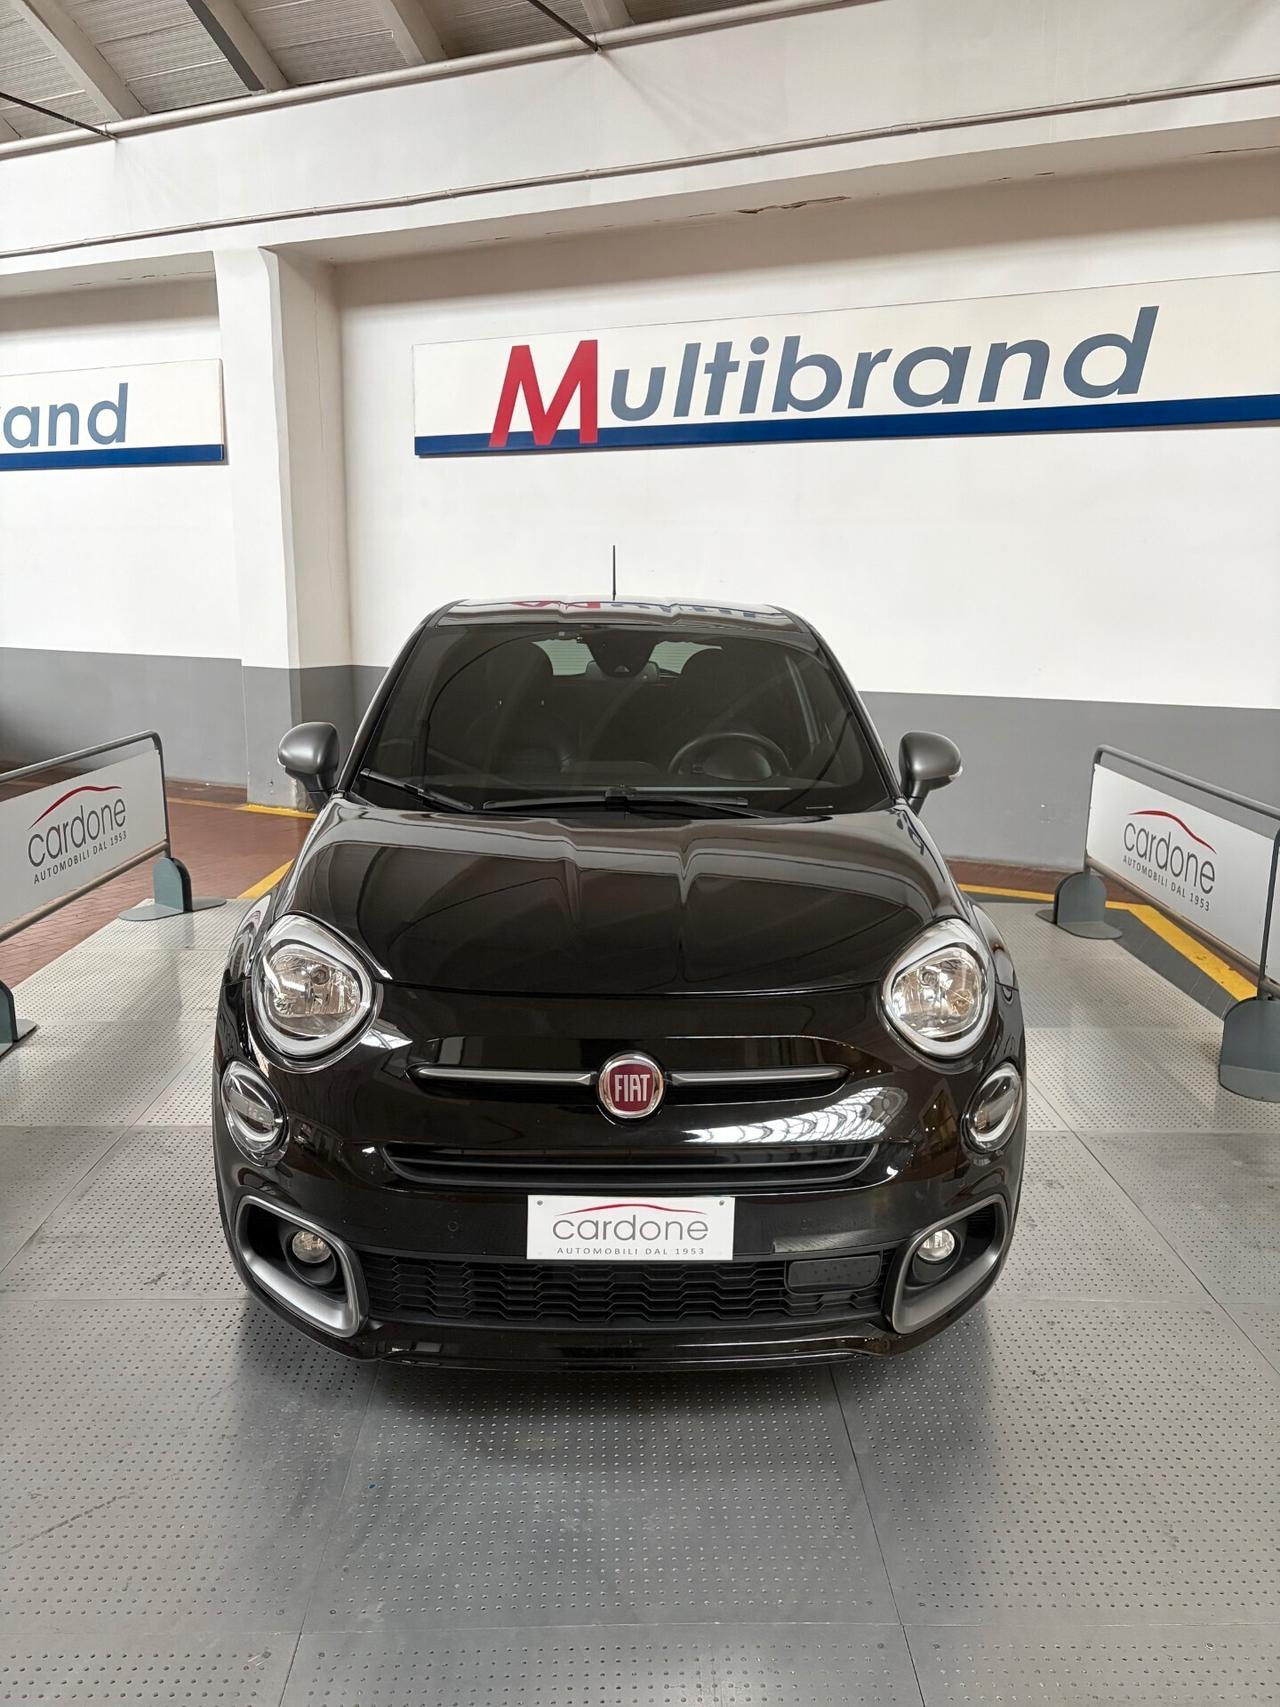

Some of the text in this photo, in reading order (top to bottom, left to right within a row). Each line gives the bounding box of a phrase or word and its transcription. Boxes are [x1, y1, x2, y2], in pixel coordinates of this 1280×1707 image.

[488, 305, 1160, 447] Multibrand
[0, 382, 128, 448] and
[28, 798, 126, 867] cardone
[33, 830, 127, 885] AUTOMOBILI DAL 1953
[1123, 822, 1215, 895] cardone
[1122, 855, 1210, 912] AUTOMOBILI DAL 1953
[614, 1074, 650, 1102] FIAT
[552, 1214, 709, 1241] cardone
[556, 1247, 704, 1255] AUTOMOBILI DAL 1953
